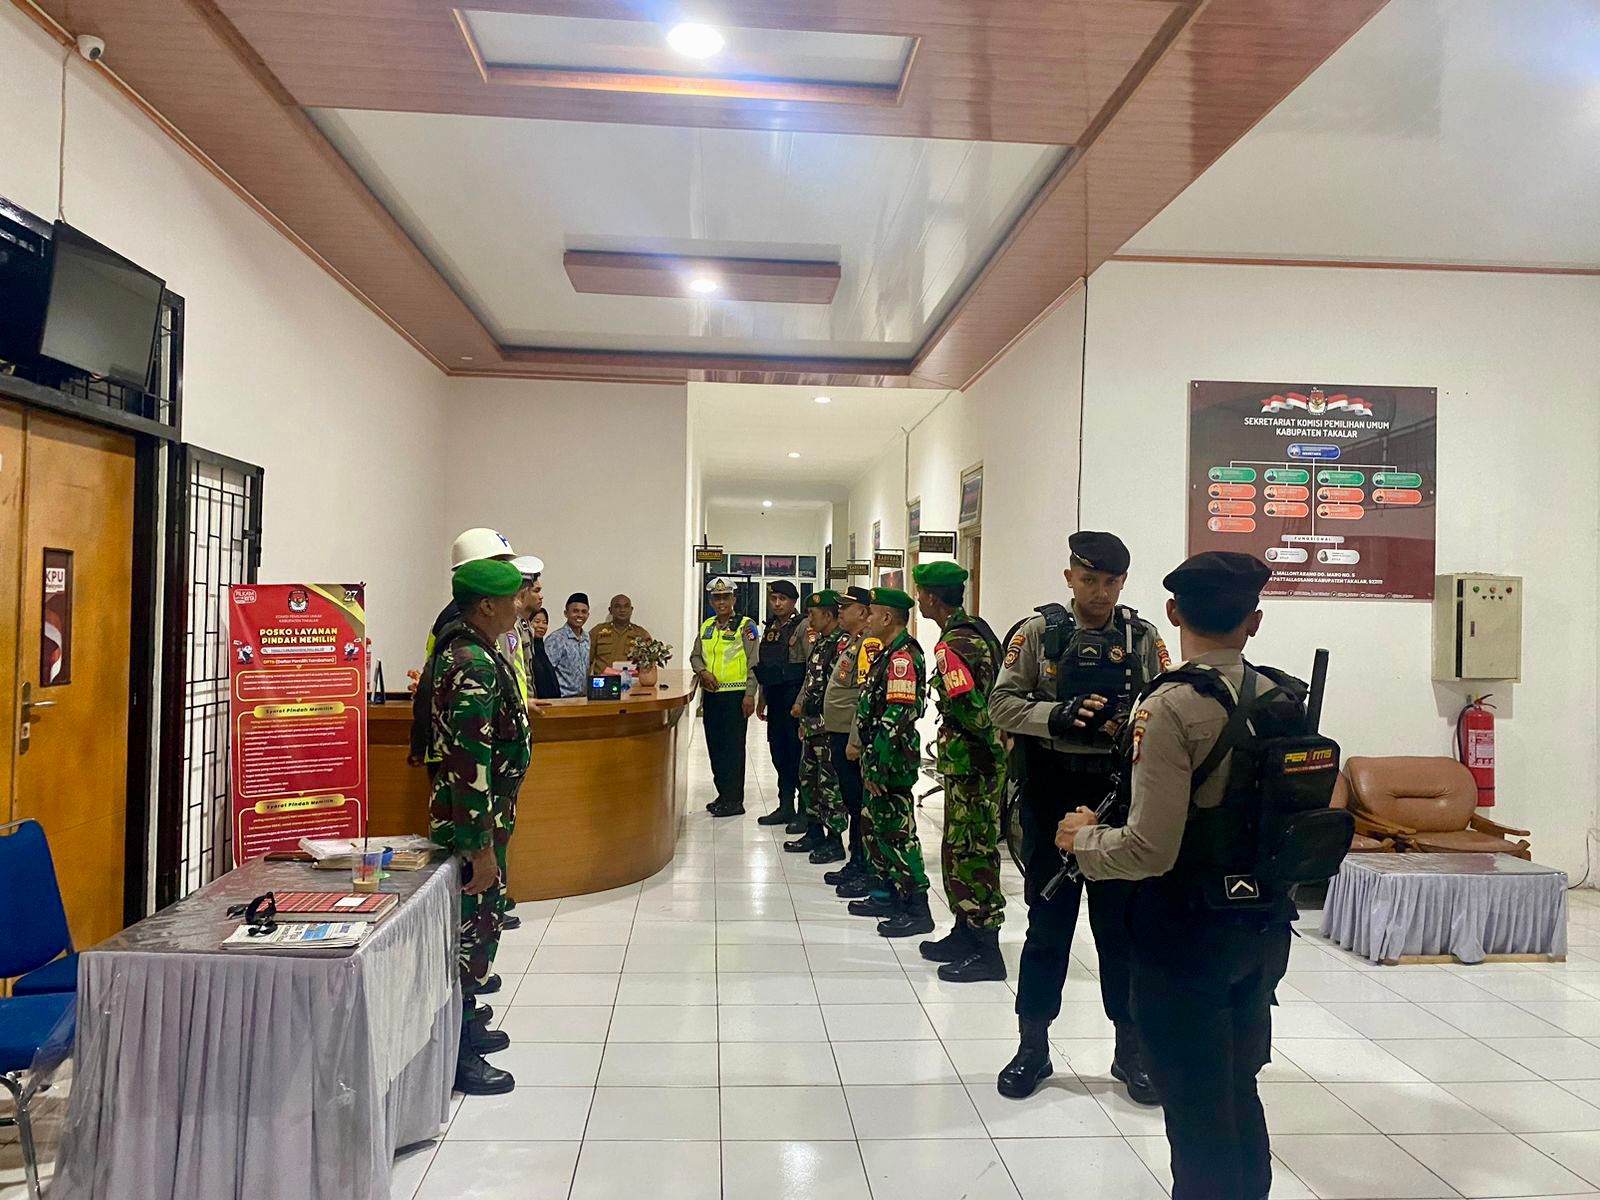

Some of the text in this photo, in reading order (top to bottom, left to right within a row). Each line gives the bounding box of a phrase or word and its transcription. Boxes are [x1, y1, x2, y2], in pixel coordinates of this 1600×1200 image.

[1244, 417, 1389, 429] SEKRETARIAT KOMISI PEMILIHAN UMUM
[1276, 428, 1358, 438] KABUPATEN TAKALAR
[344, 590, 358, 601] 27
[259, 627, 338, 636] POSKO LAYANAN
[261, 636, 336, 644] PINDAH MEMILIH
